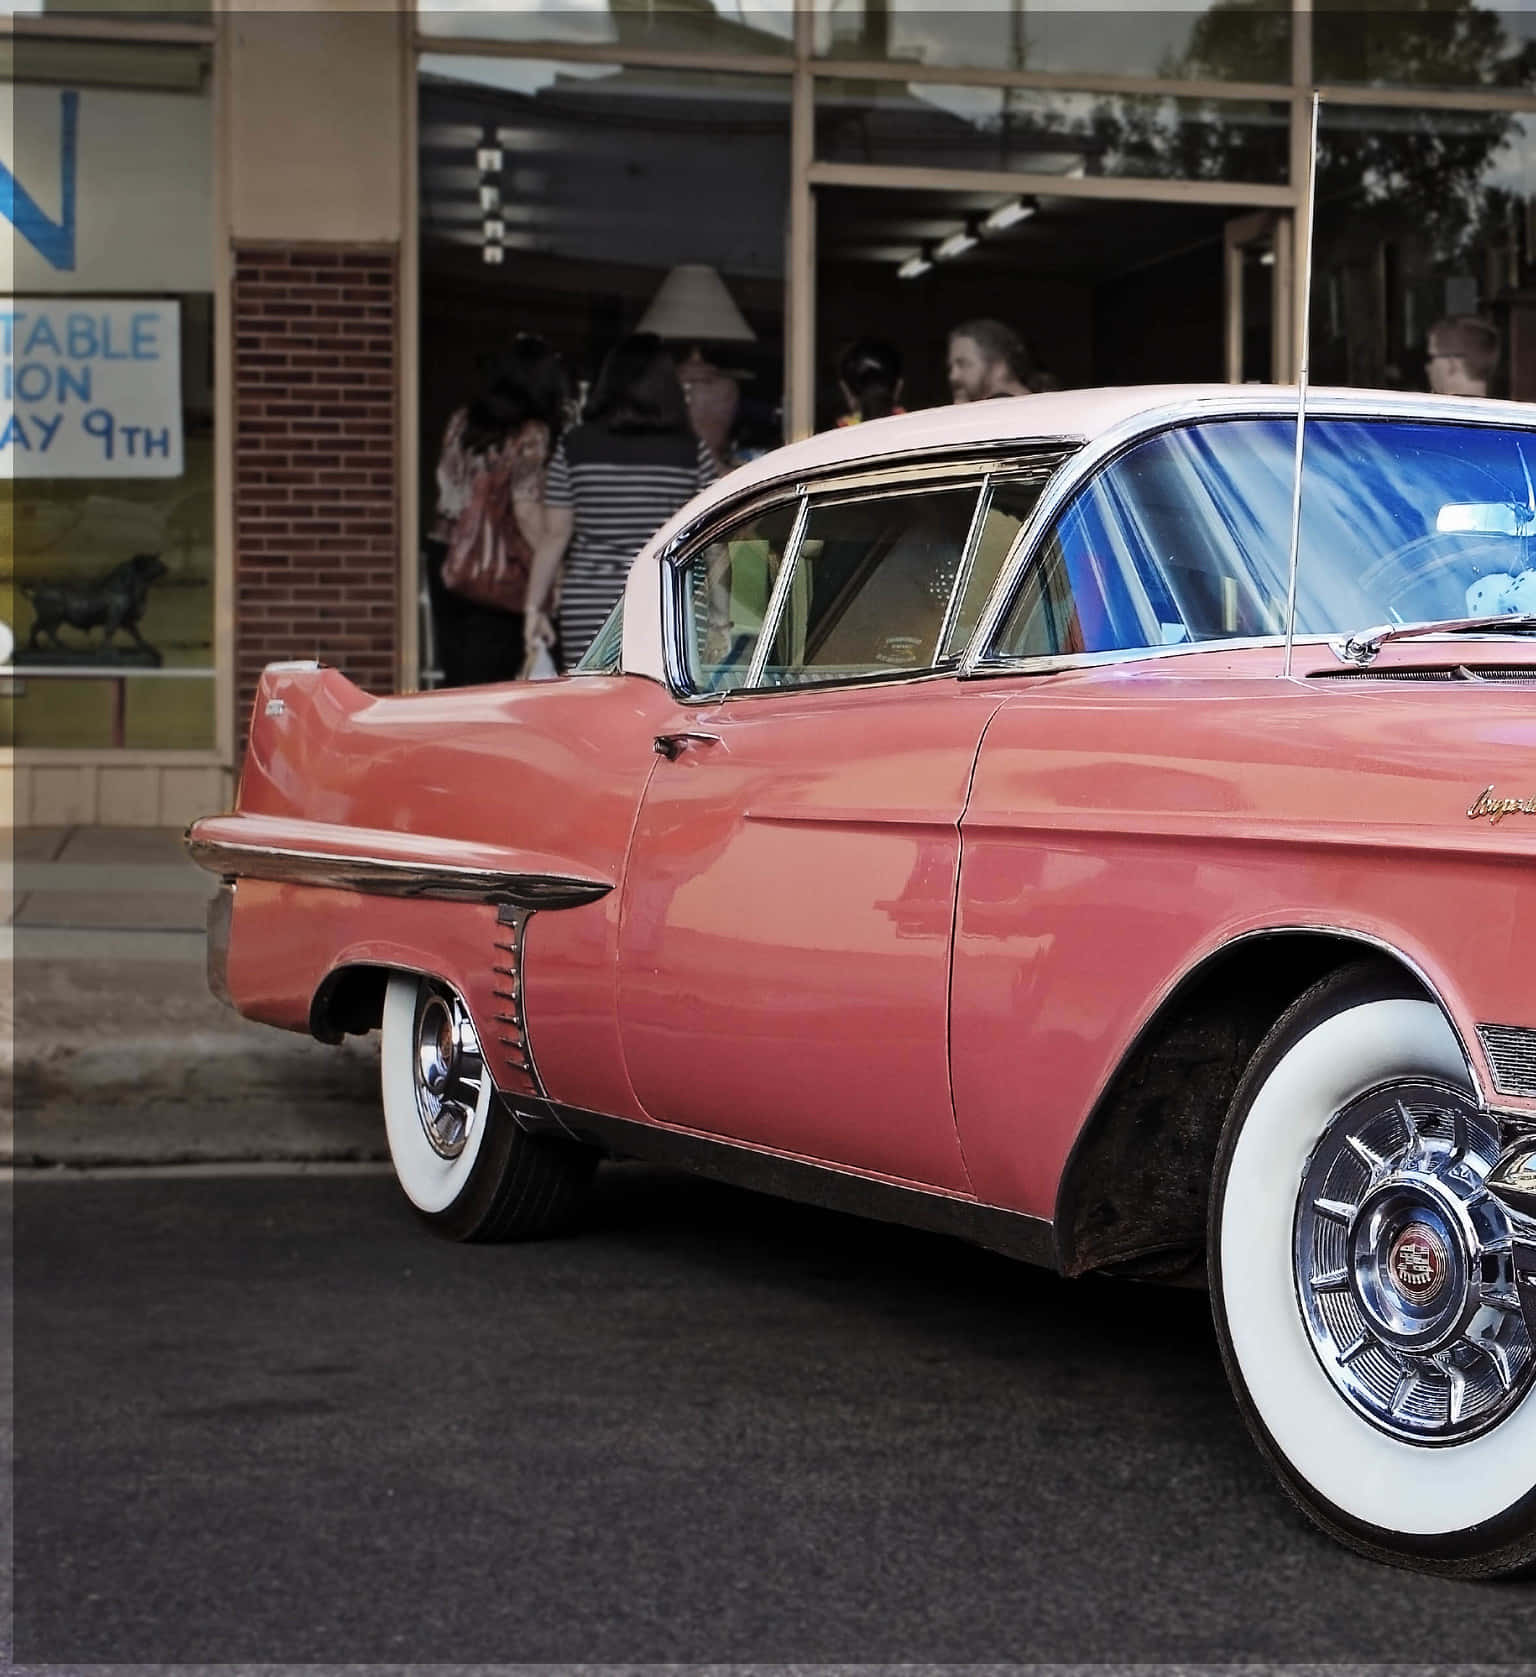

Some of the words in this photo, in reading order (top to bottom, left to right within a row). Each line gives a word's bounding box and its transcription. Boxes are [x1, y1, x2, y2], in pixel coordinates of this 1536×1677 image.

[0, 312, 161, 361] TABLE
[3, 362, 92, 404] ION
[0, 412, 65, 454] AY
[82, 408, 171, 461] 9TH
